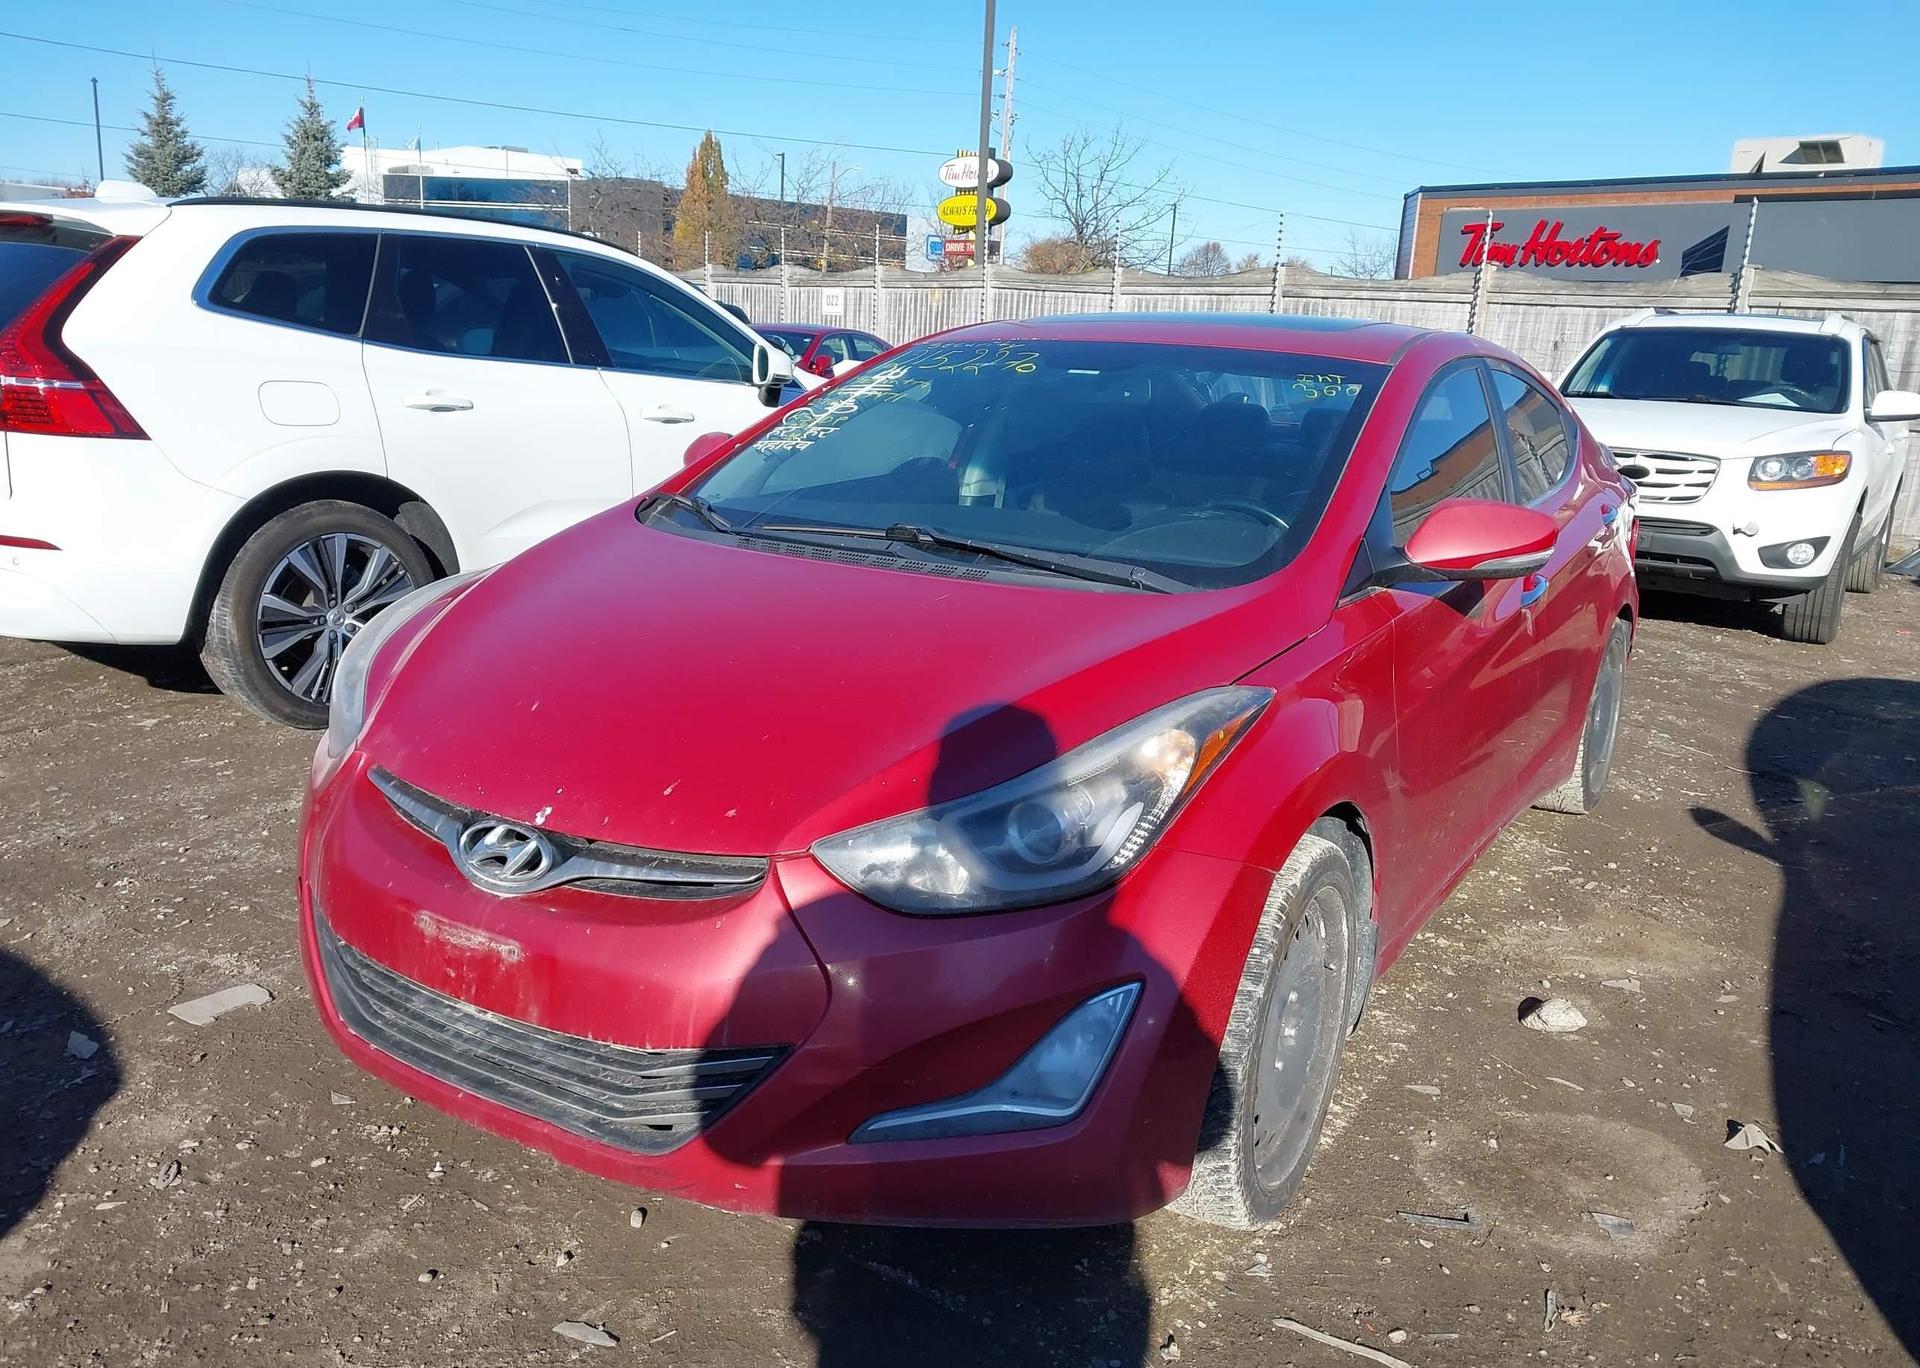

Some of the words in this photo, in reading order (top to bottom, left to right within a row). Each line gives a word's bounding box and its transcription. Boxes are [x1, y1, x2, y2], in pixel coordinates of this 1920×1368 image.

[944, 163, 960, 181] Tim
[941, 204, 967, 216] ALWAYS
[967, 204, 992, 216] FRH
[945, 242, 965, 252] DRIVE
[1459, 222, 1519, 268] Tim
[1519, 218, 1661, 268] Hortons
